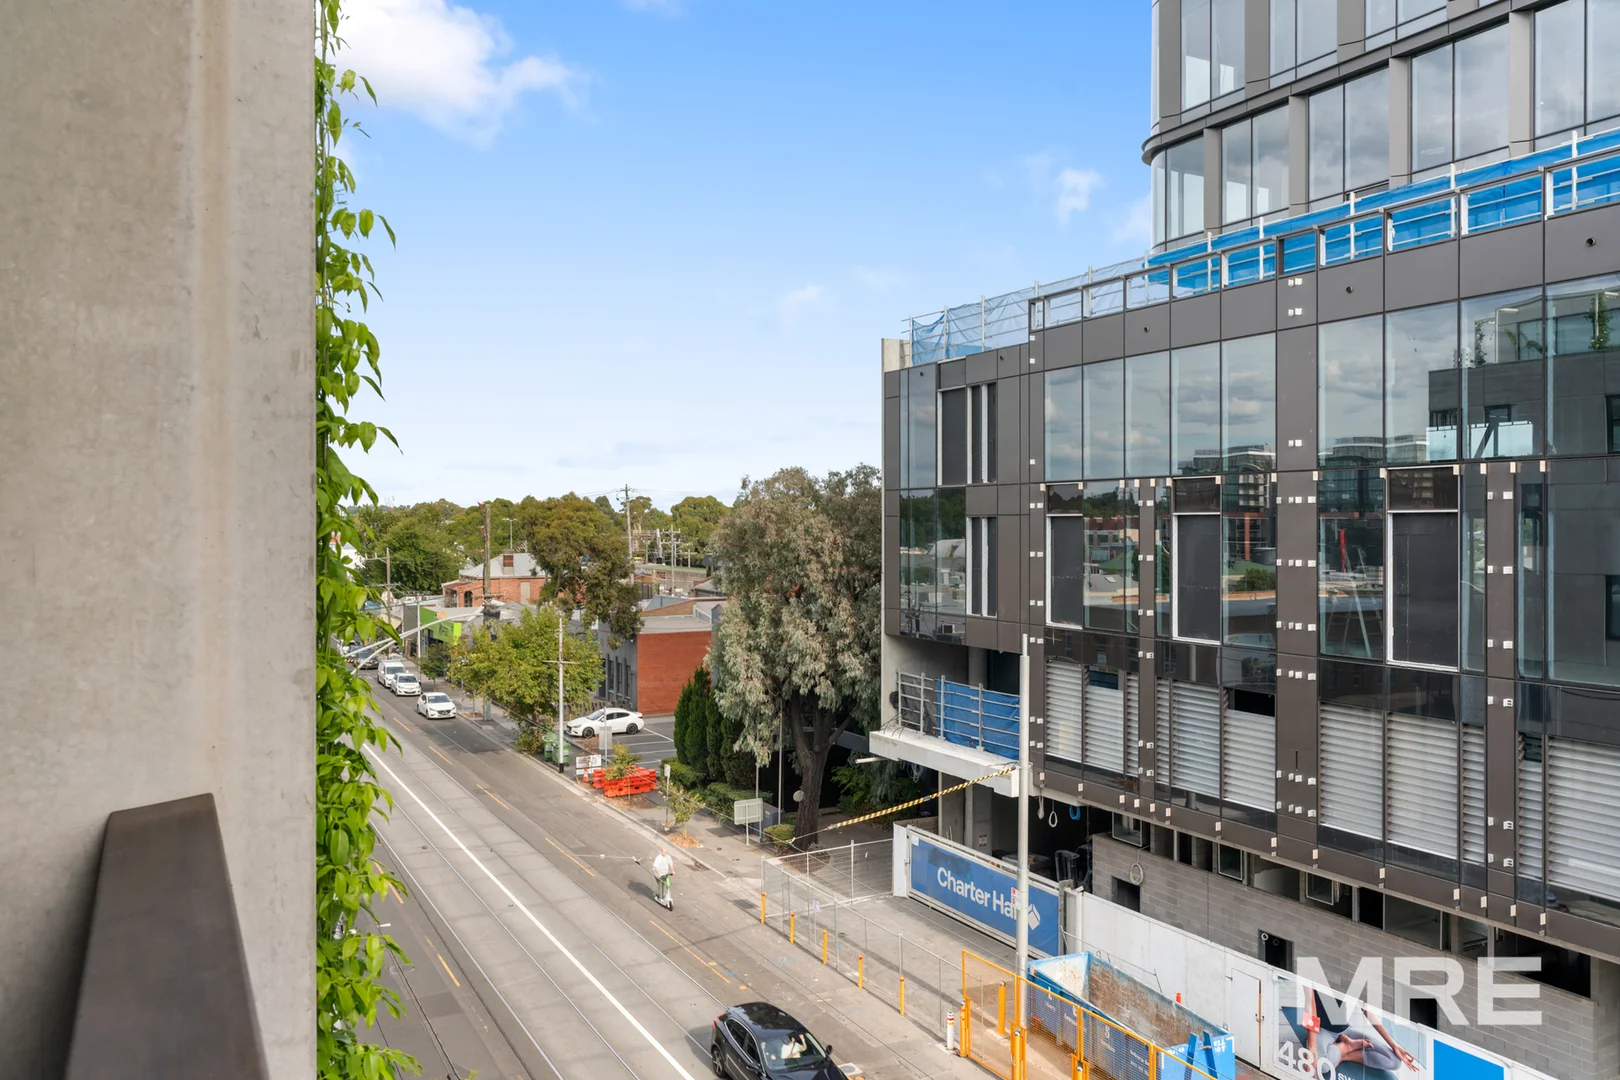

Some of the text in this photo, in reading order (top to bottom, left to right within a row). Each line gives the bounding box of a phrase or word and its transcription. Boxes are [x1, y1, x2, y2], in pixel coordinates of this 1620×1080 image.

[937, 866, 990, 907] Charter
[993, 889, 1017, 921] Hal
[1277, 1040, 1336, 1080] 480
